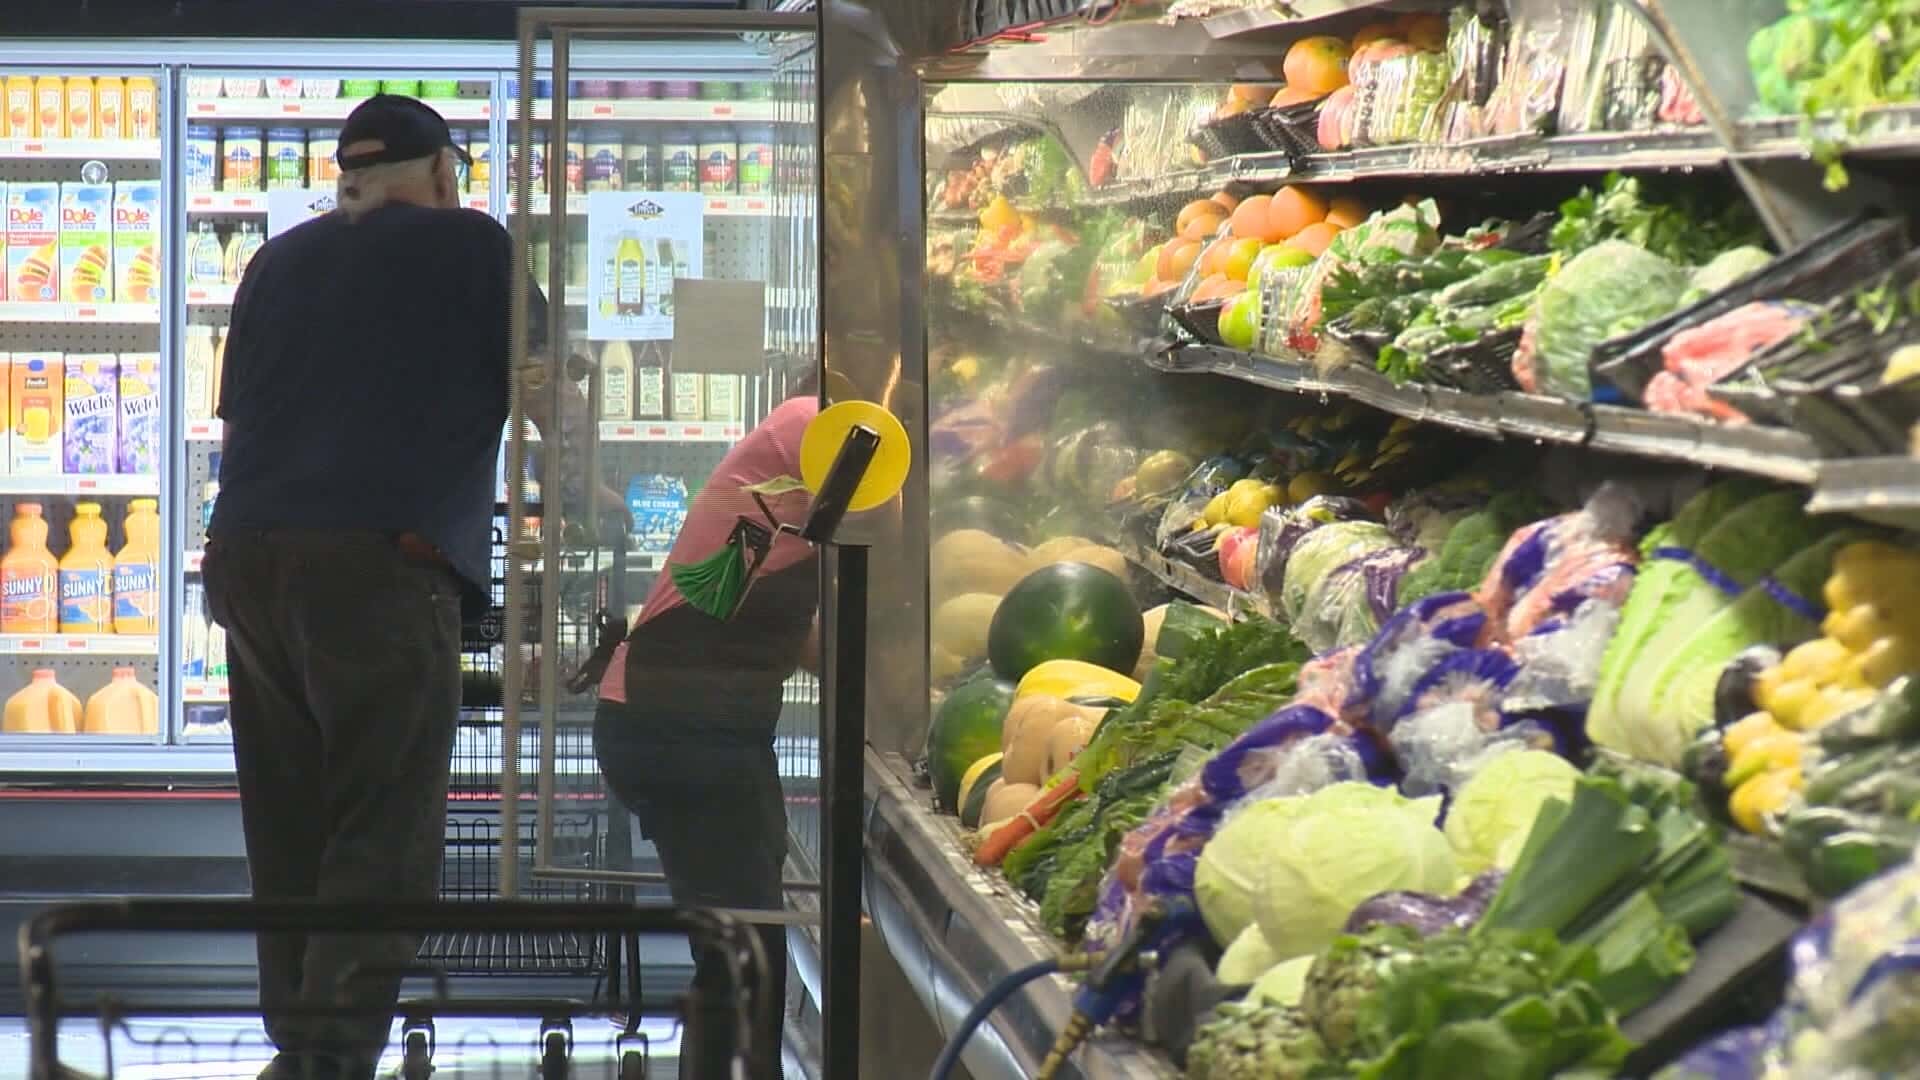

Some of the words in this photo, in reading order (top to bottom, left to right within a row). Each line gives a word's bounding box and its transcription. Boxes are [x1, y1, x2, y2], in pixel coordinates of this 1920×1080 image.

[10, 208, 43, 223] Dole
[63, 208, 96, 223] Dole
[117, 208, 150, 223] Dole
[68, 394, 114, 416] Welch's
[632, 500, 651, 508] BLUE
